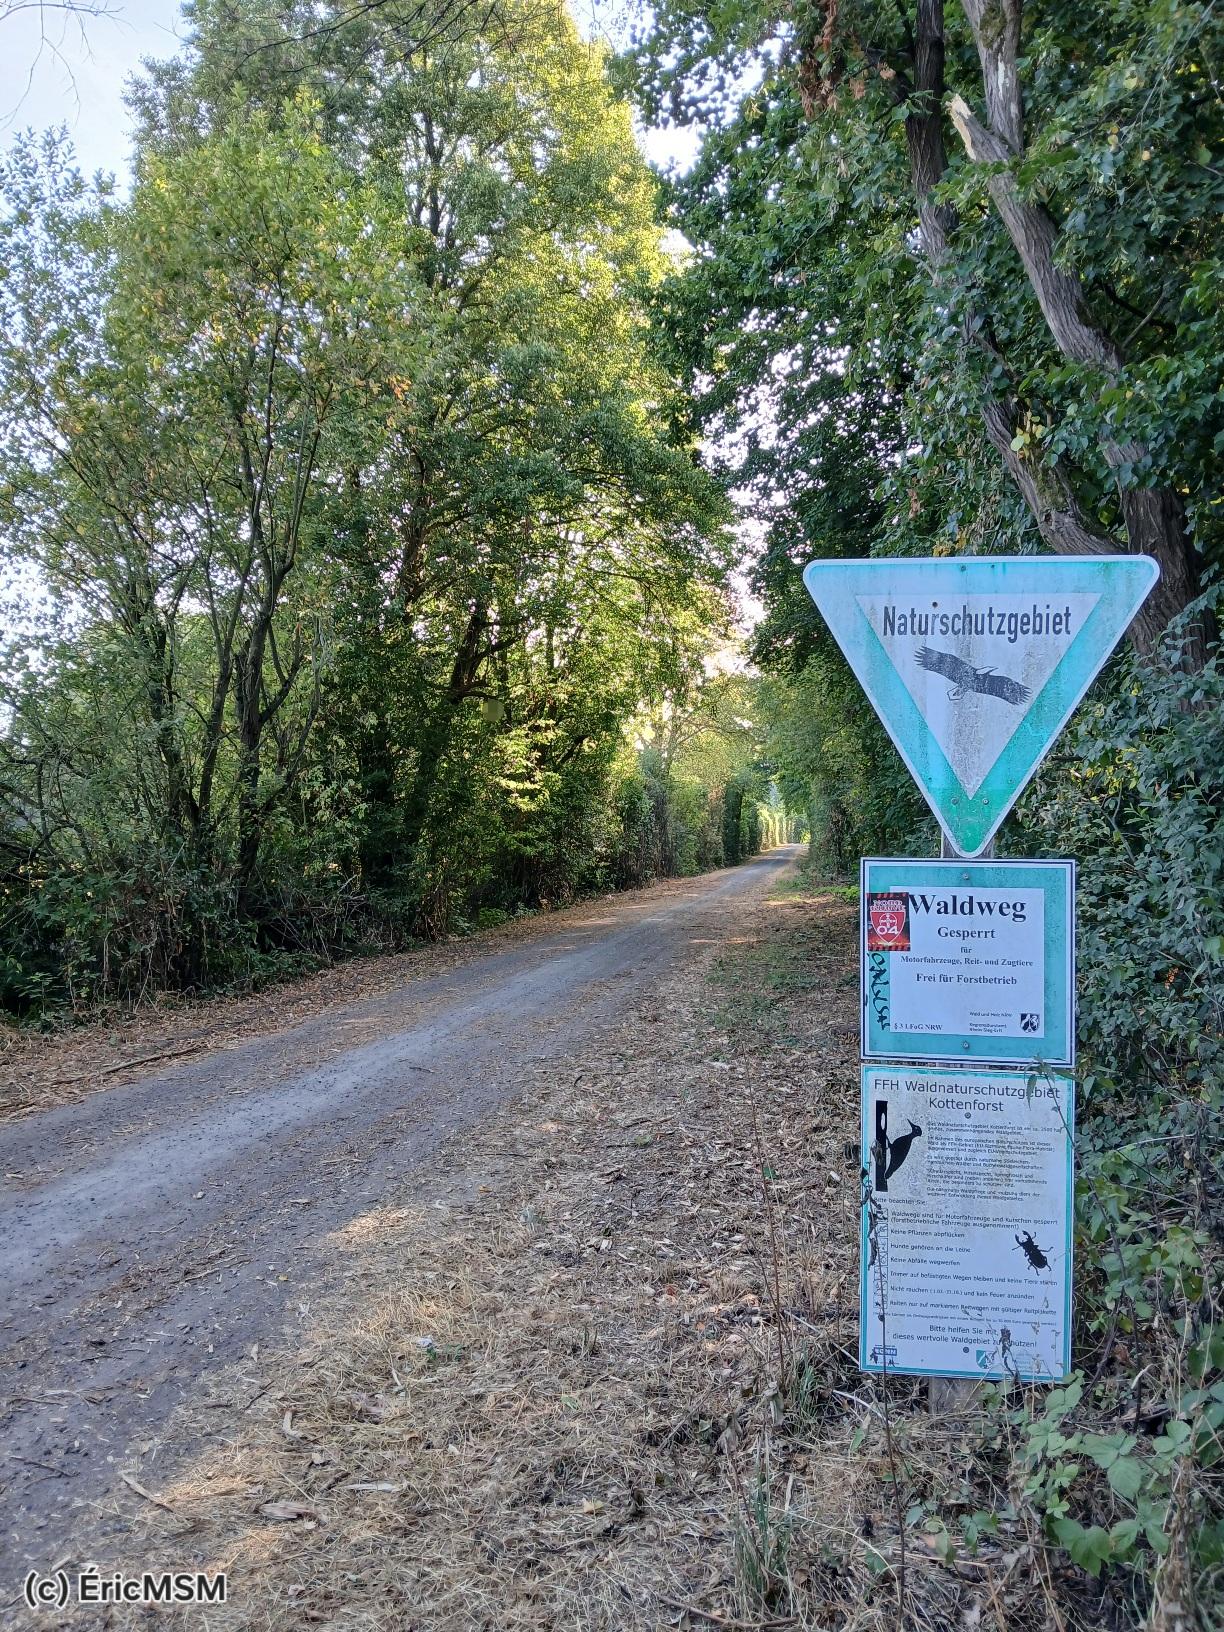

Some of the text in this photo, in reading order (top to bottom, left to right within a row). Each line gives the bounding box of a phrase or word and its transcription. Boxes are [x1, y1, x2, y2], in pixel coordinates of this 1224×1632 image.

[883, 604, 1072, 643] Naturschutzgebiet
[908, 894, 1027, 922] Waldweg
[937, 926, 996, 940] Gesperrt
[960, 946, 973, 954] für
[901, 955, 962, 965] Motorfahrzeuge,
[984, 958, 999, 966] und
[1001, 958, 1034, 967] Zugtiere
[916, 973, 1018, 985] Frei für Forstbetrieb
[874, 1079, 1061, 1100] FFH Waldnaturschutzgbiet
[929, 1097, 1005, 1112] Kottenforst
[929, 1324, 946, 1333] Bitte
[947, 1325, 970, 1334] helfen
[971, 1327, 983, 1335] Sie
[892, 1333, 915, 1341] dieses
[916, 1334, 949, 1343] wertvolle
[950, 1335, 990, 1346] Waldgebiet
